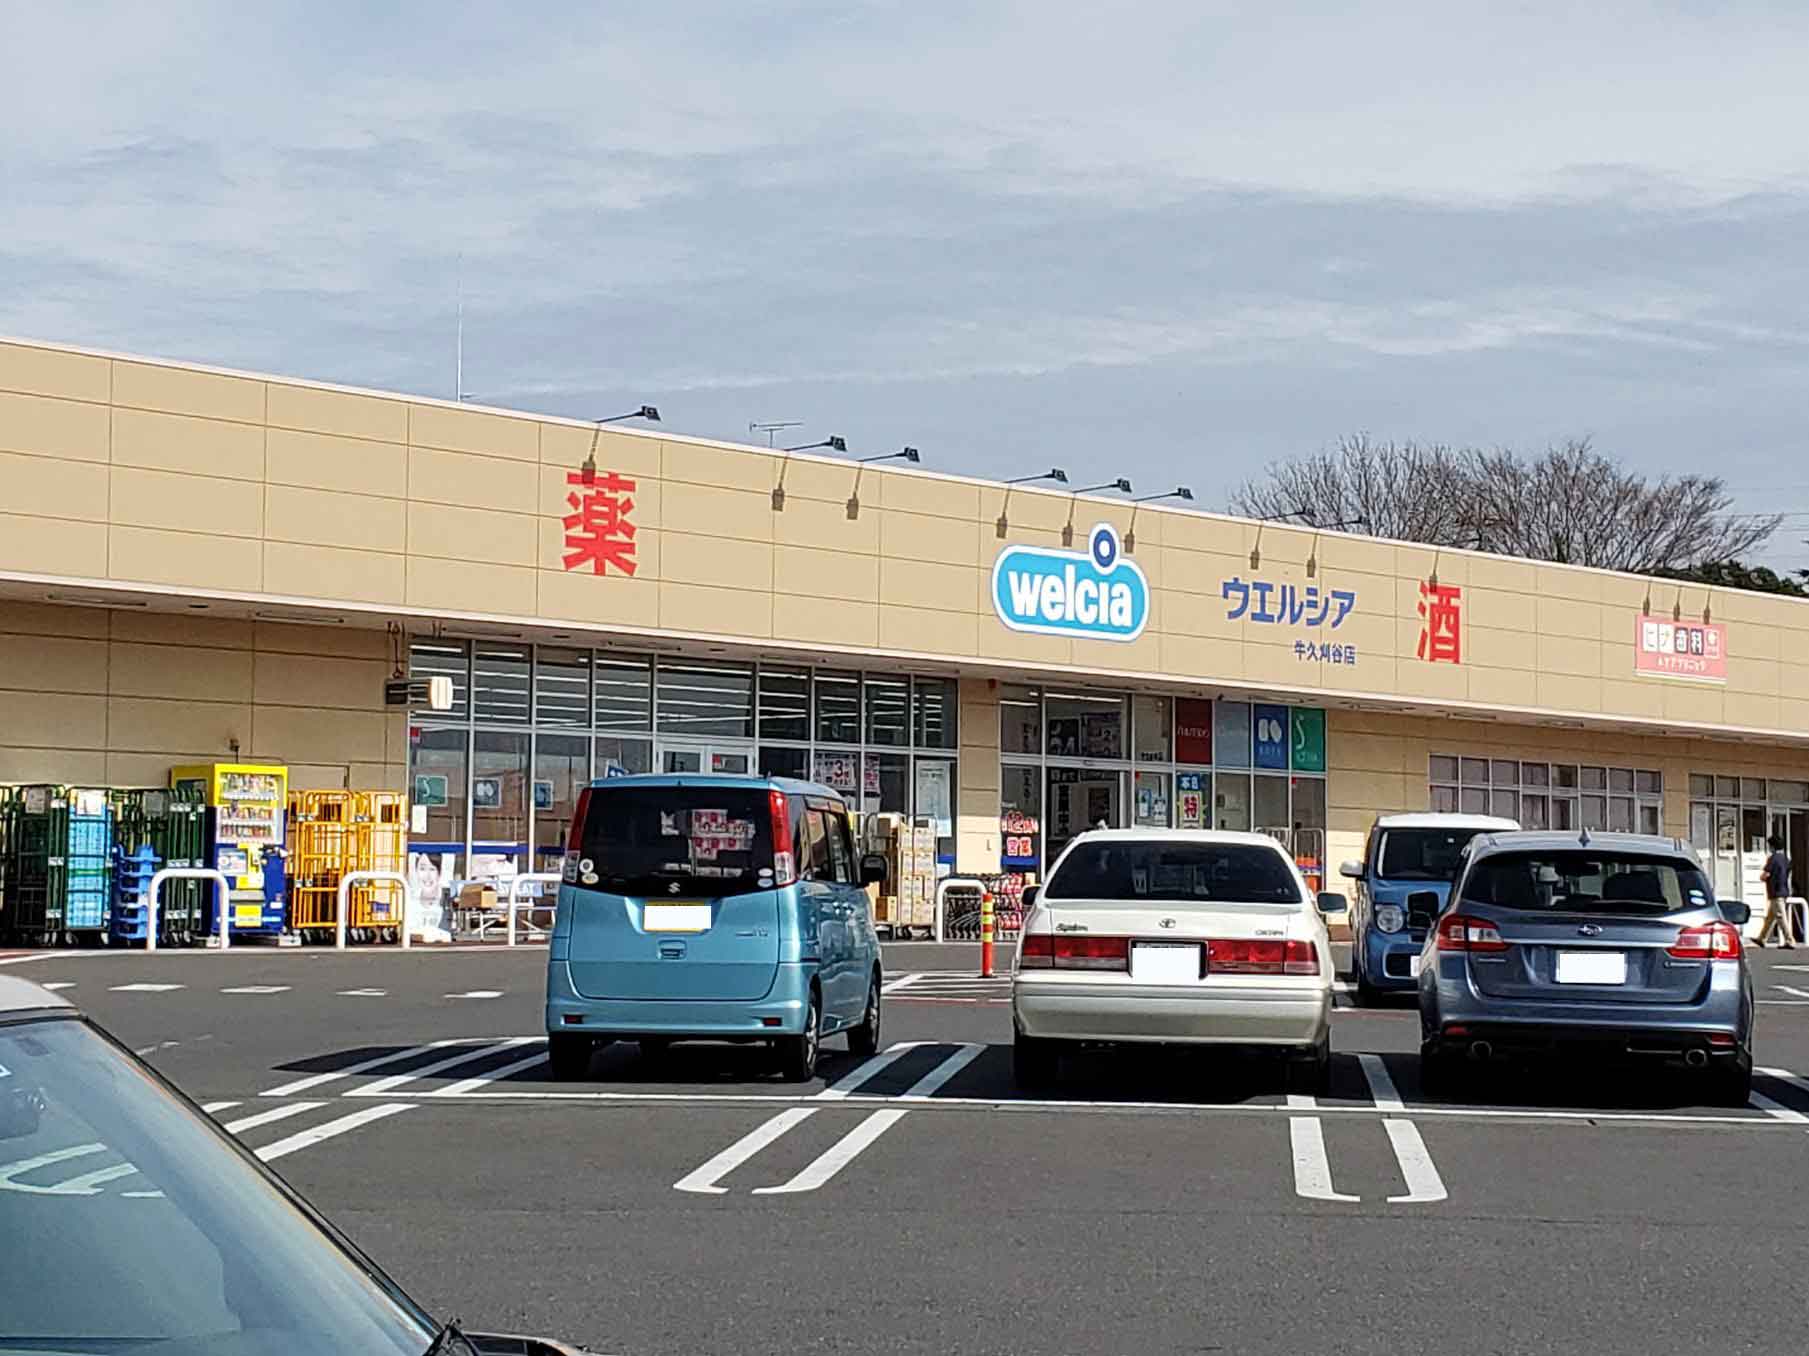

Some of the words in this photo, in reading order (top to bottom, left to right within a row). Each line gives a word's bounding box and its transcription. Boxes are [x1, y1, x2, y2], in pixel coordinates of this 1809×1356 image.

[562, 471, 638, 577] 薬
[1008, 530, 1133, 627] welcia
[1222, 576, 1356, 628] ウエルシア
[1294, 639, 1356, 665] 牛久刈谷店
[1417, 580, 1462, 664] 酒
